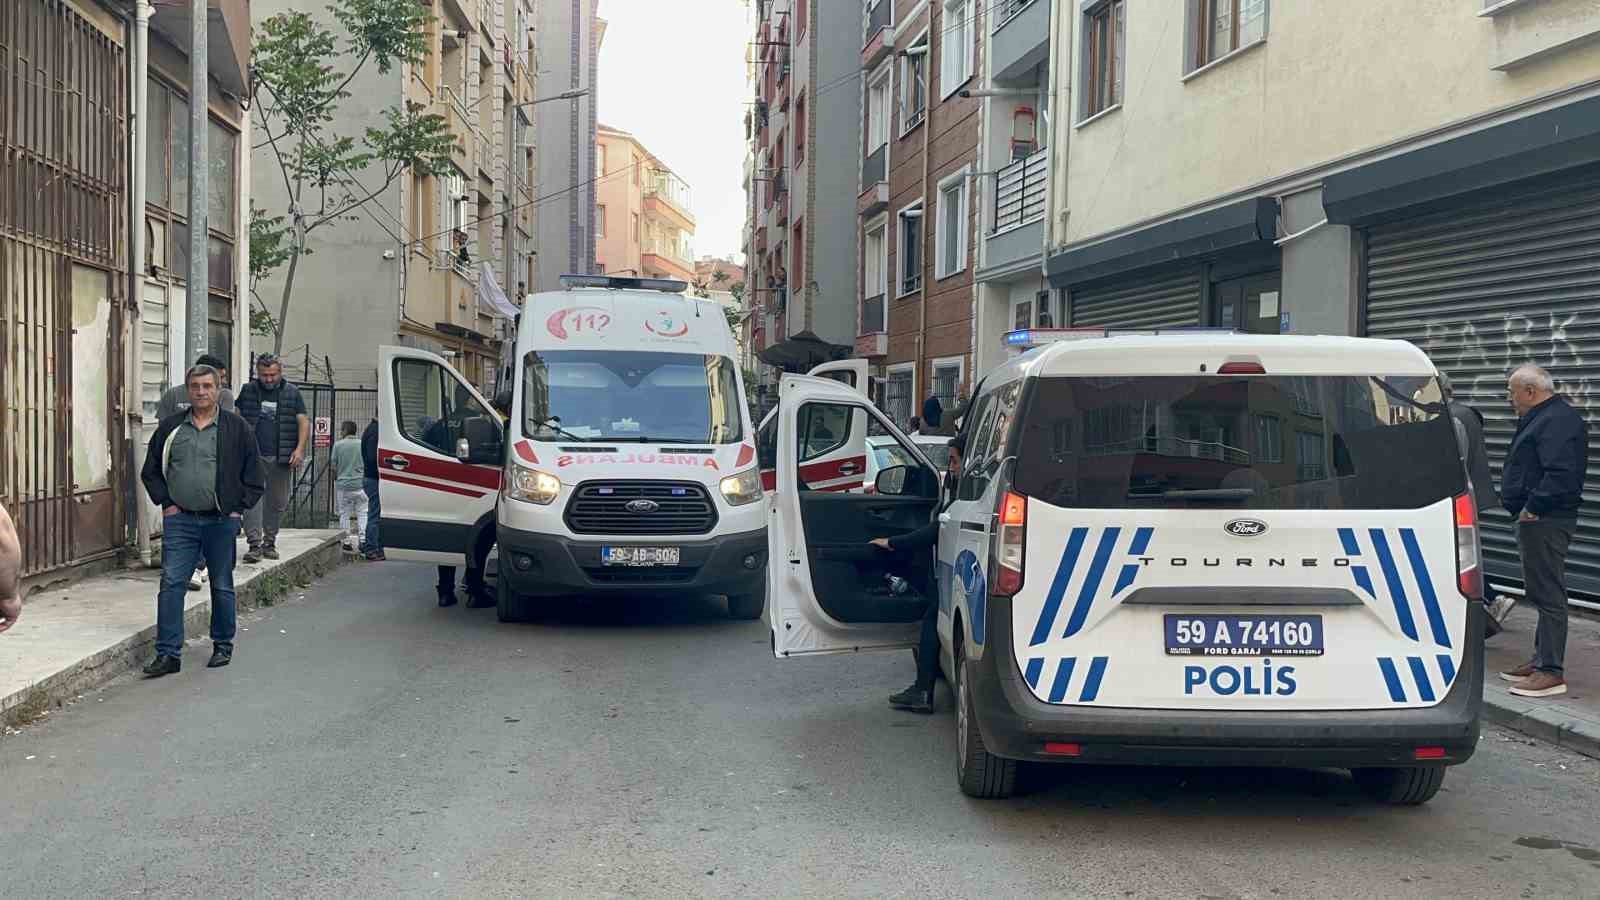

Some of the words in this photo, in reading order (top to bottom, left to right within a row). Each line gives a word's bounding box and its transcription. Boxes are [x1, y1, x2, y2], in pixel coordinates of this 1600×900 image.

[1231, 520, 1260, 534] Ford
[609, 547, 624, 561] 59
[1138, 557, 1350, 567] TOURNEO
[1176, 620, 1206, 644] 59
[1214, 621, 1232, 644] A
[1238, 621, 1312, 645] 74160
[1184, 658, 1297, 695] POLİS
